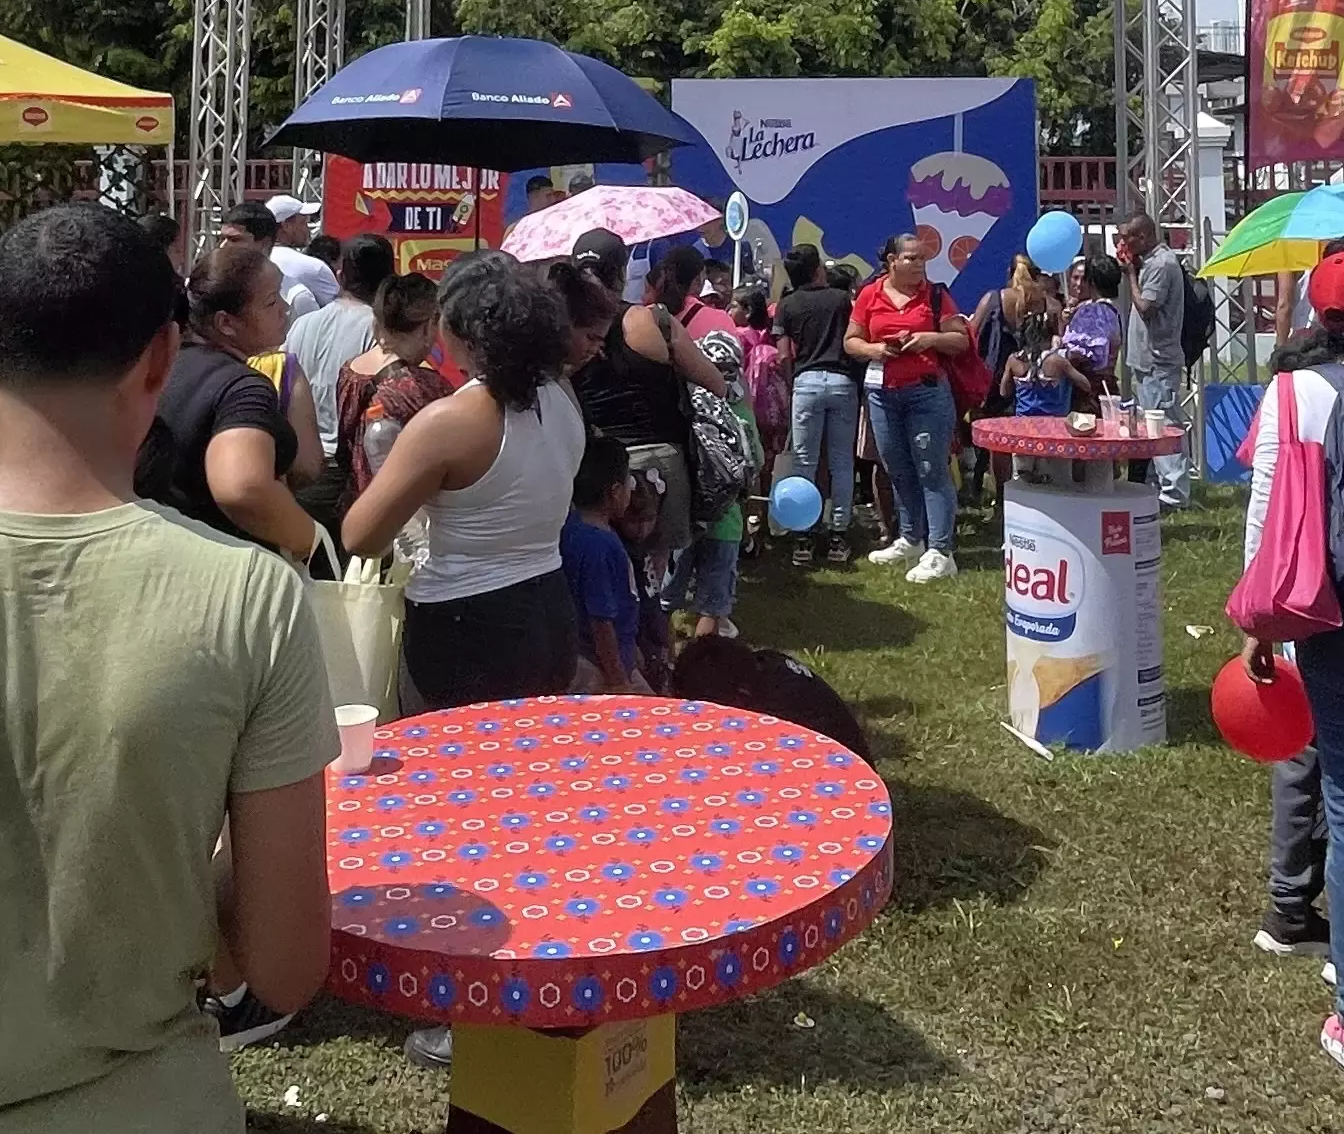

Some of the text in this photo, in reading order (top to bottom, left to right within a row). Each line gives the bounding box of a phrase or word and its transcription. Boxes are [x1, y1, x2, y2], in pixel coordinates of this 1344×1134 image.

[332, 92, 400, 105] Banco Aliado
[472, 92, 550, 105] Banco Aliado
[741, 132, 816, 161] Lechera
[749, 126, 764, 143] La
[376, 163, 407, 189] DAR
[411, 163, 431, 189] LO
[405, 206, 441, 230] DE TI
[1006, 548, 1070, 604] deal
